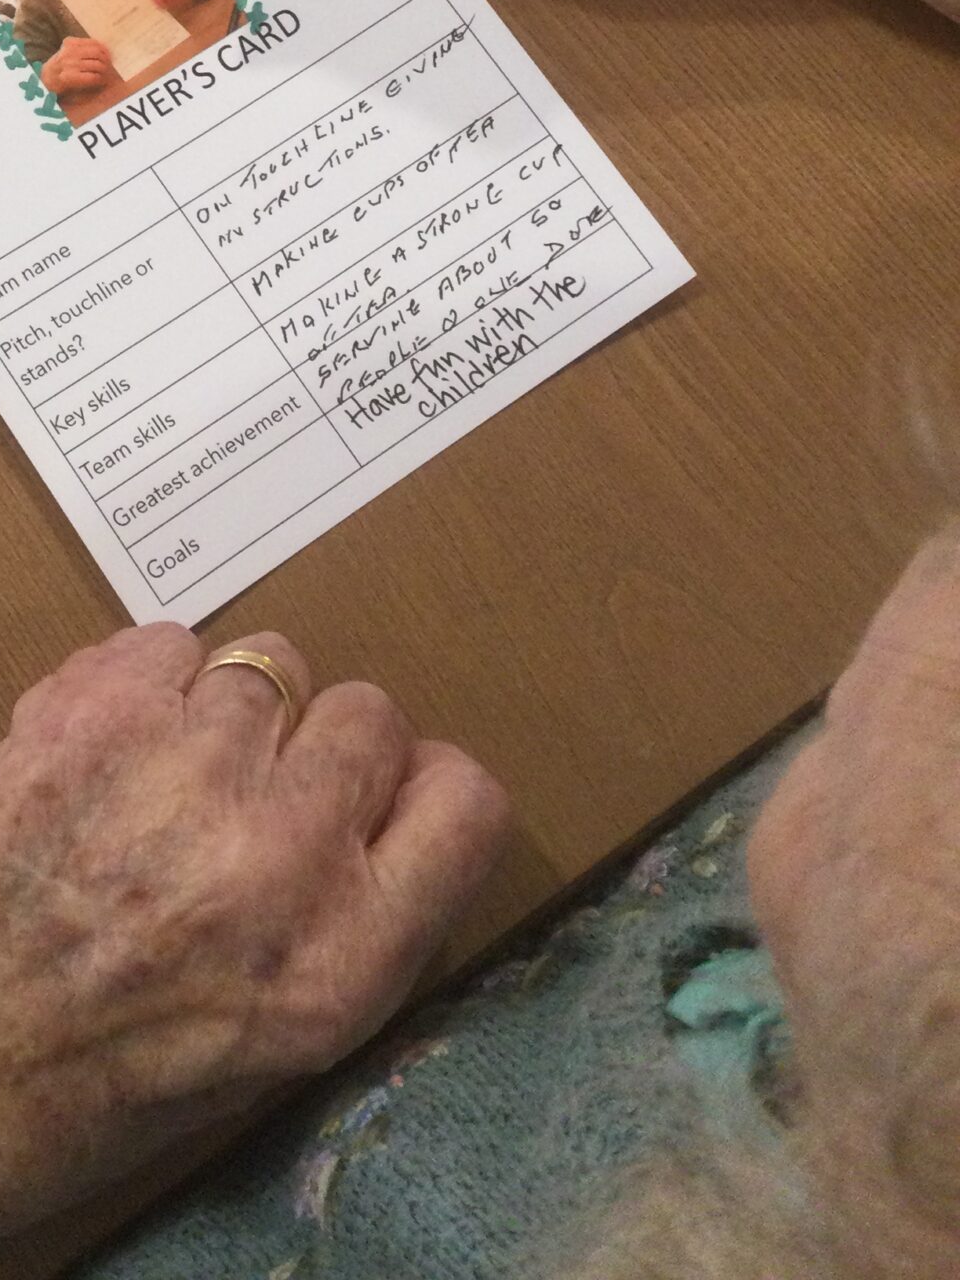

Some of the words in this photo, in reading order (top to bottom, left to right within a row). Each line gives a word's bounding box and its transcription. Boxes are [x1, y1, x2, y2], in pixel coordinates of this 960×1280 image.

[74, 58, 219, 161] PLAYER'S
[217, 6, 304, 65] CARD
[21, 245, 71, 282] name
[439, 228, 512, 301] ABOUT
[0, 324, 53, 360] Pitch,
[50, 273, 133, 329] touchline
[135, 257, 154, 277] or
[20, 334, 85, 386] stands?
[343, 380, 412, 429] Have
[410, 350, 466, 391] fun
[463, 306, 535, 354] with
[528, 275, 585, 311] the
[416, 333, 540, 417] children
[49, 406, 86, 435] Key
[87, 378, 131, 413] skills
[78, 444, 133, 480] Team
[133, 414, 176, 449] skills
[112, 470, 191, 527] Greatest
[190, 396, 302, 478] achievement
[146, 538, 201, 579] Goals
